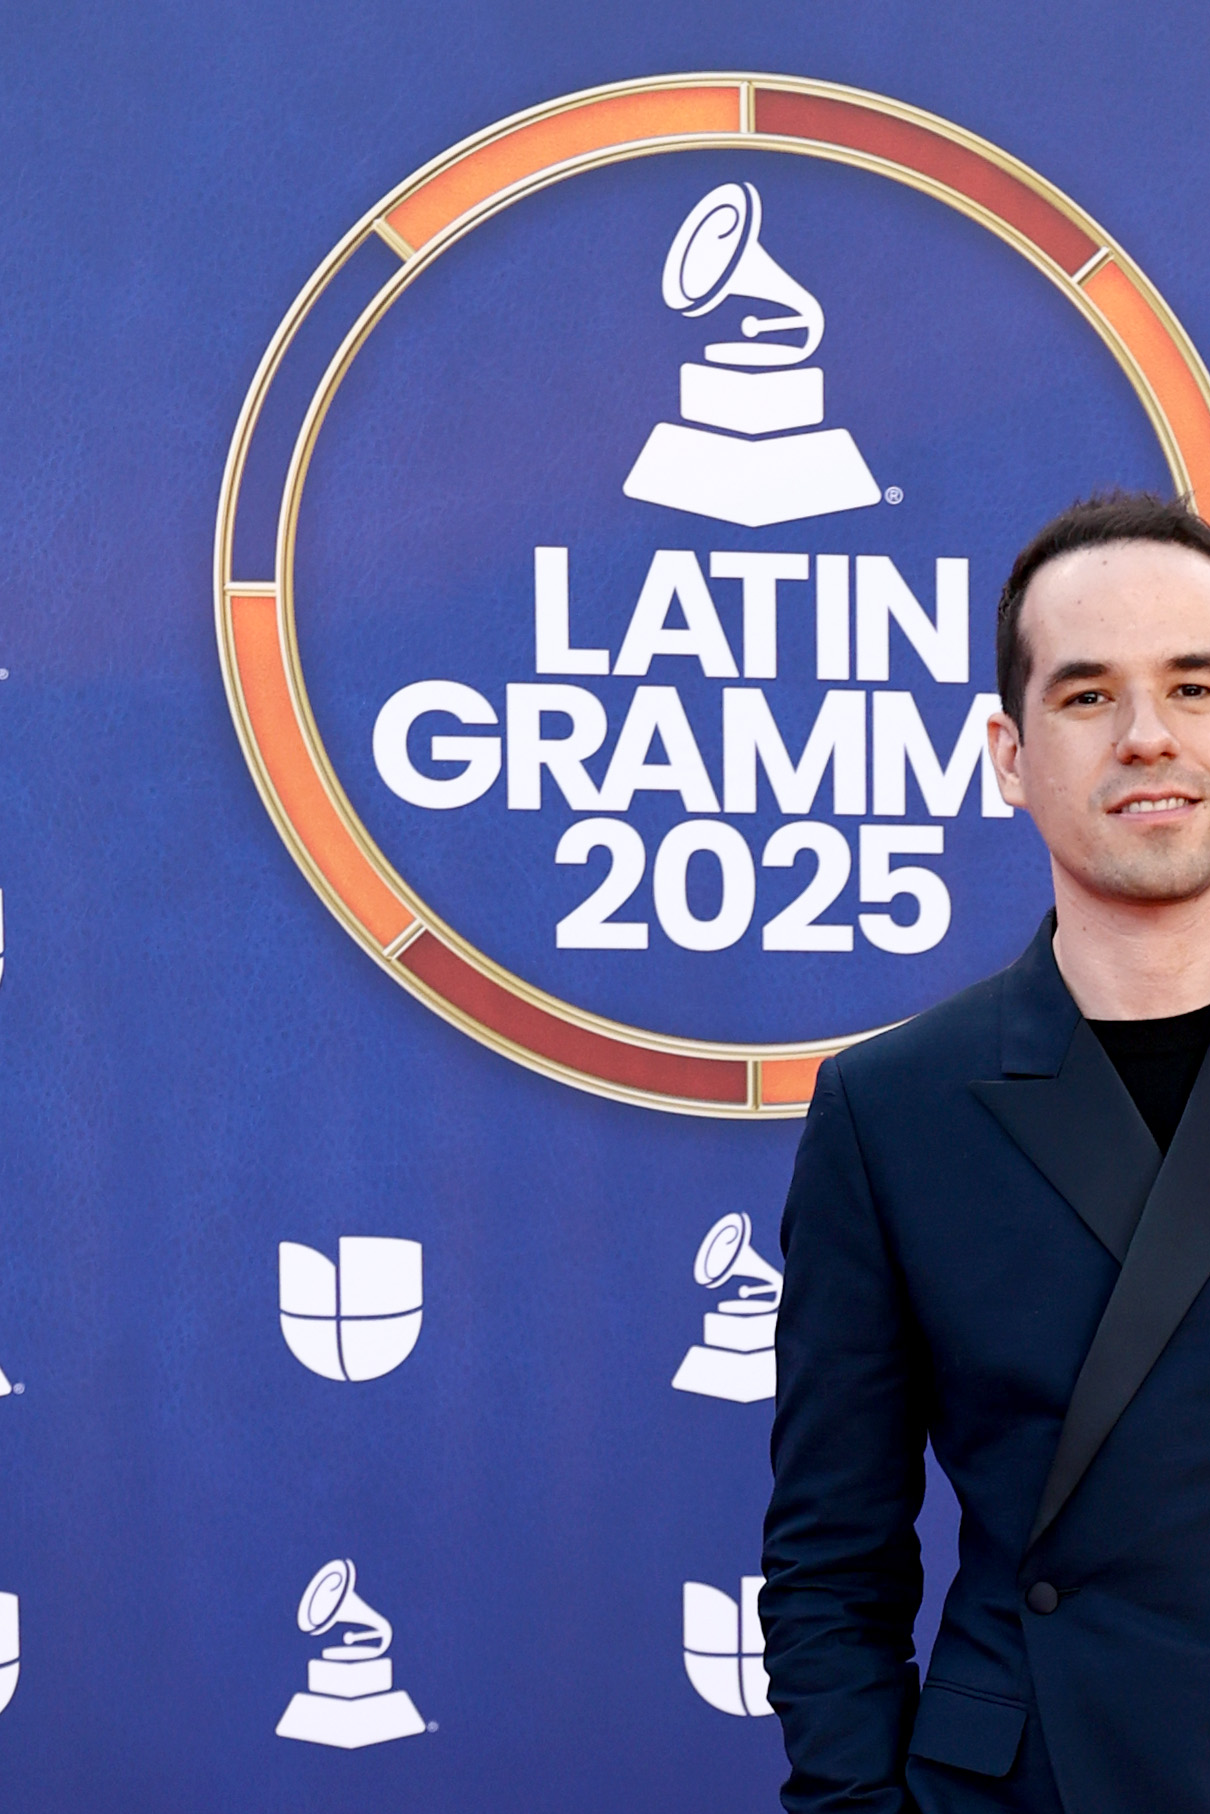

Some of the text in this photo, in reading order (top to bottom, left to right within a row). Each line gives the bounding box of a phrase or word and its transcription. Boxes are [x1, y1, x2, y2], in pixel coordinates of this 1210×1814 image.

[533, 546, 970, 683] LATIN
[371, 680, 1015, 818] GRAMM
[554, 817, 952, 954] 2025
